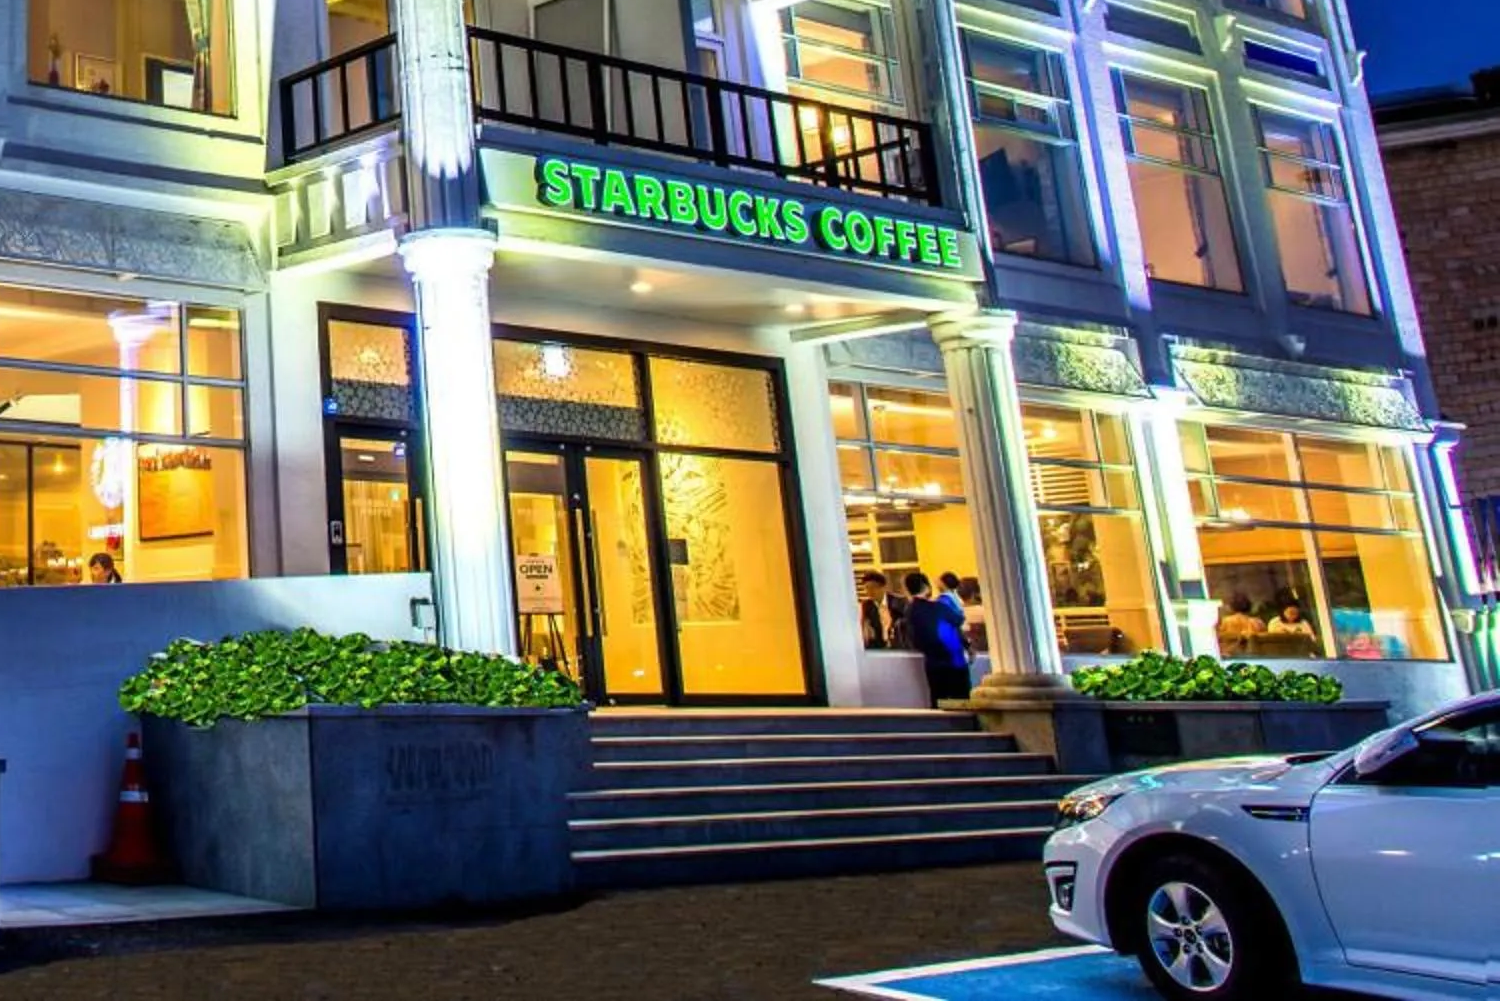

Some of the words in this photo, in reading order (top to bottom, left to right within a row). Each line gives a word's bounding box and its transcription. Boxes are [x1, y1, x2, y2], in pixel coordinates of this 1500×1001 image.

[536, 158, 809, 243] STARBUCKS
[813, 206, 963, 268] COFFEE
[519, 564, 553, 574] OPEN
